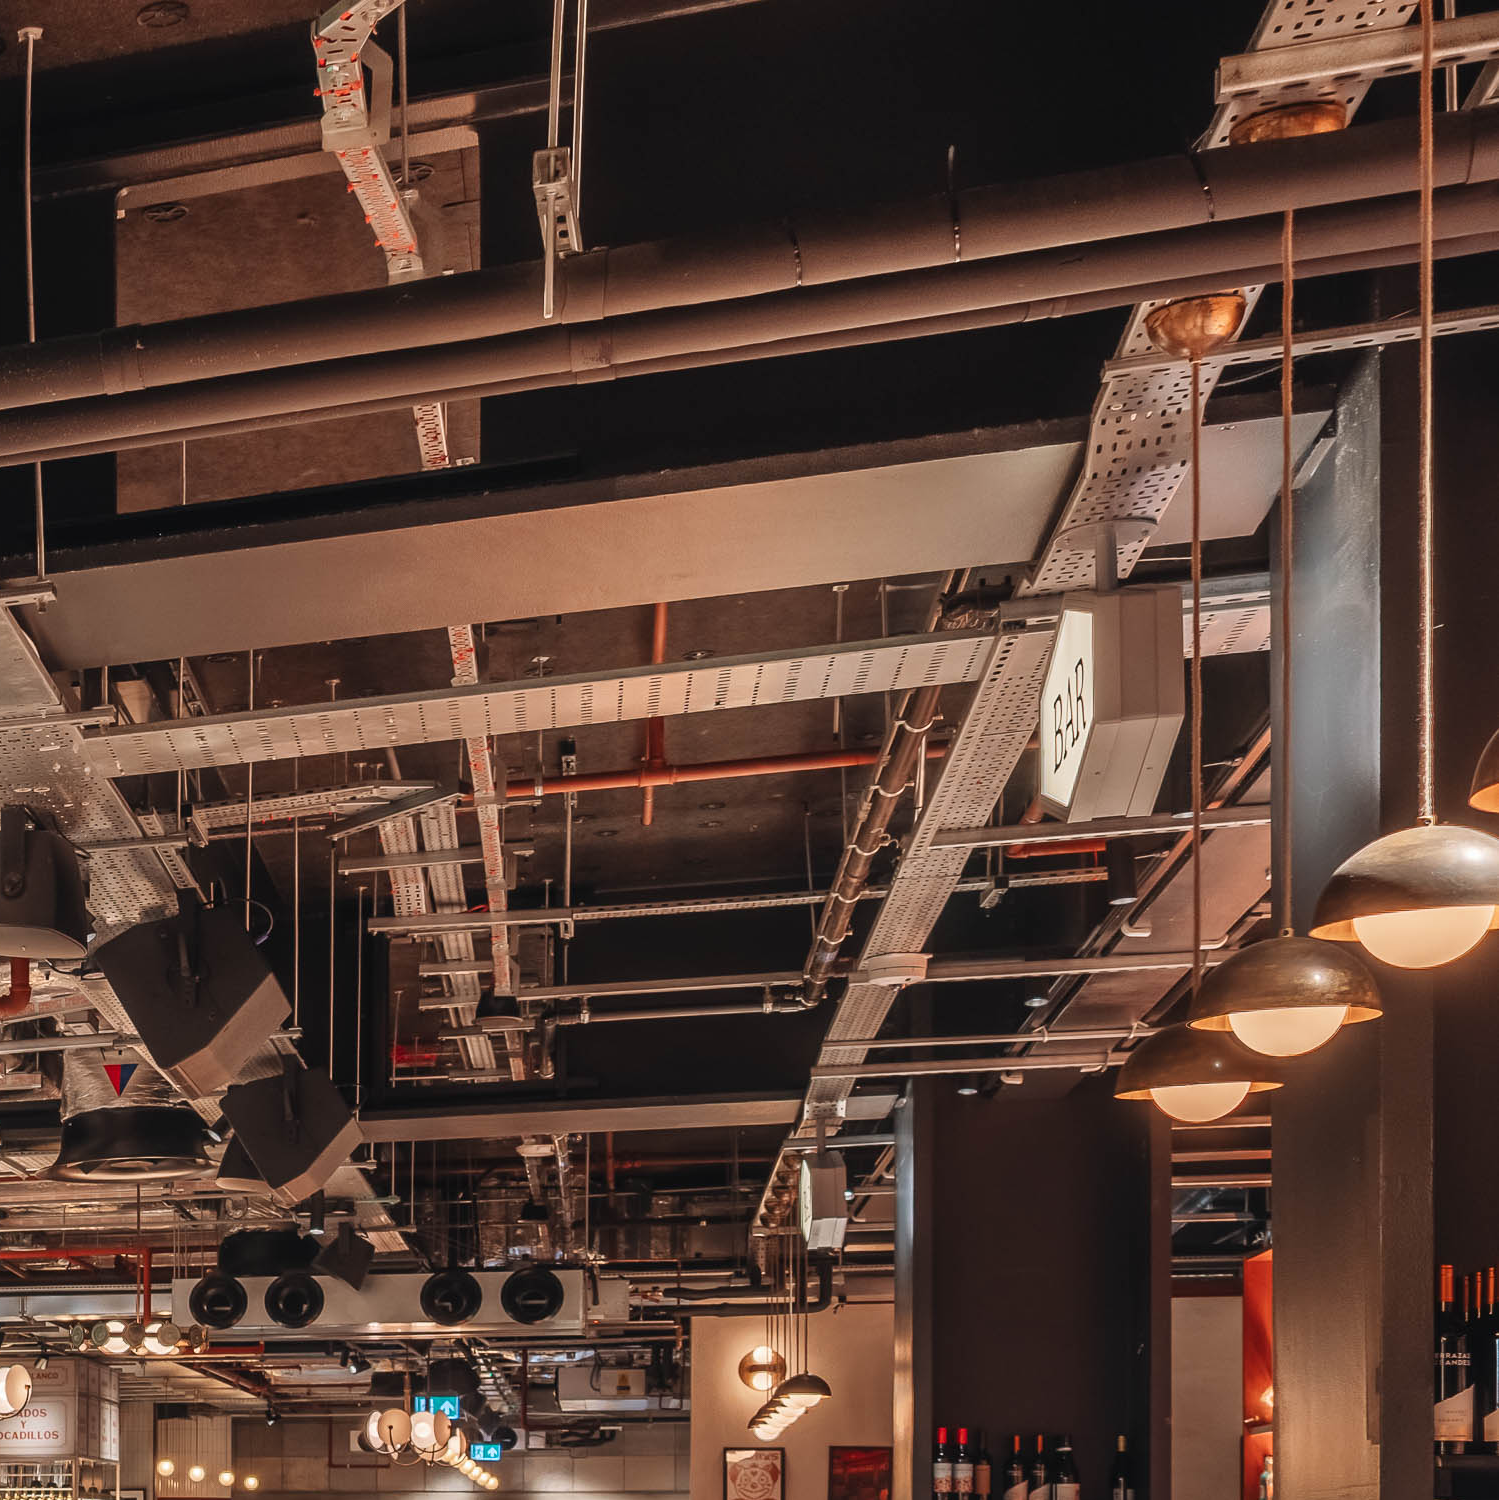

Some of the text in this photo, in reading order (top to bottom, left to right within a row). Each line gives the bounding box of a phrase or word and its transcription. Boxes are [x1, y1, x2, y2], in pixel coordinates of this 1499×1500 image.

[1054, 657, 1086, 774] BAR
[31, 1372, 59, 1380] LANCO
[21, 1420, 27, 1428] Y
